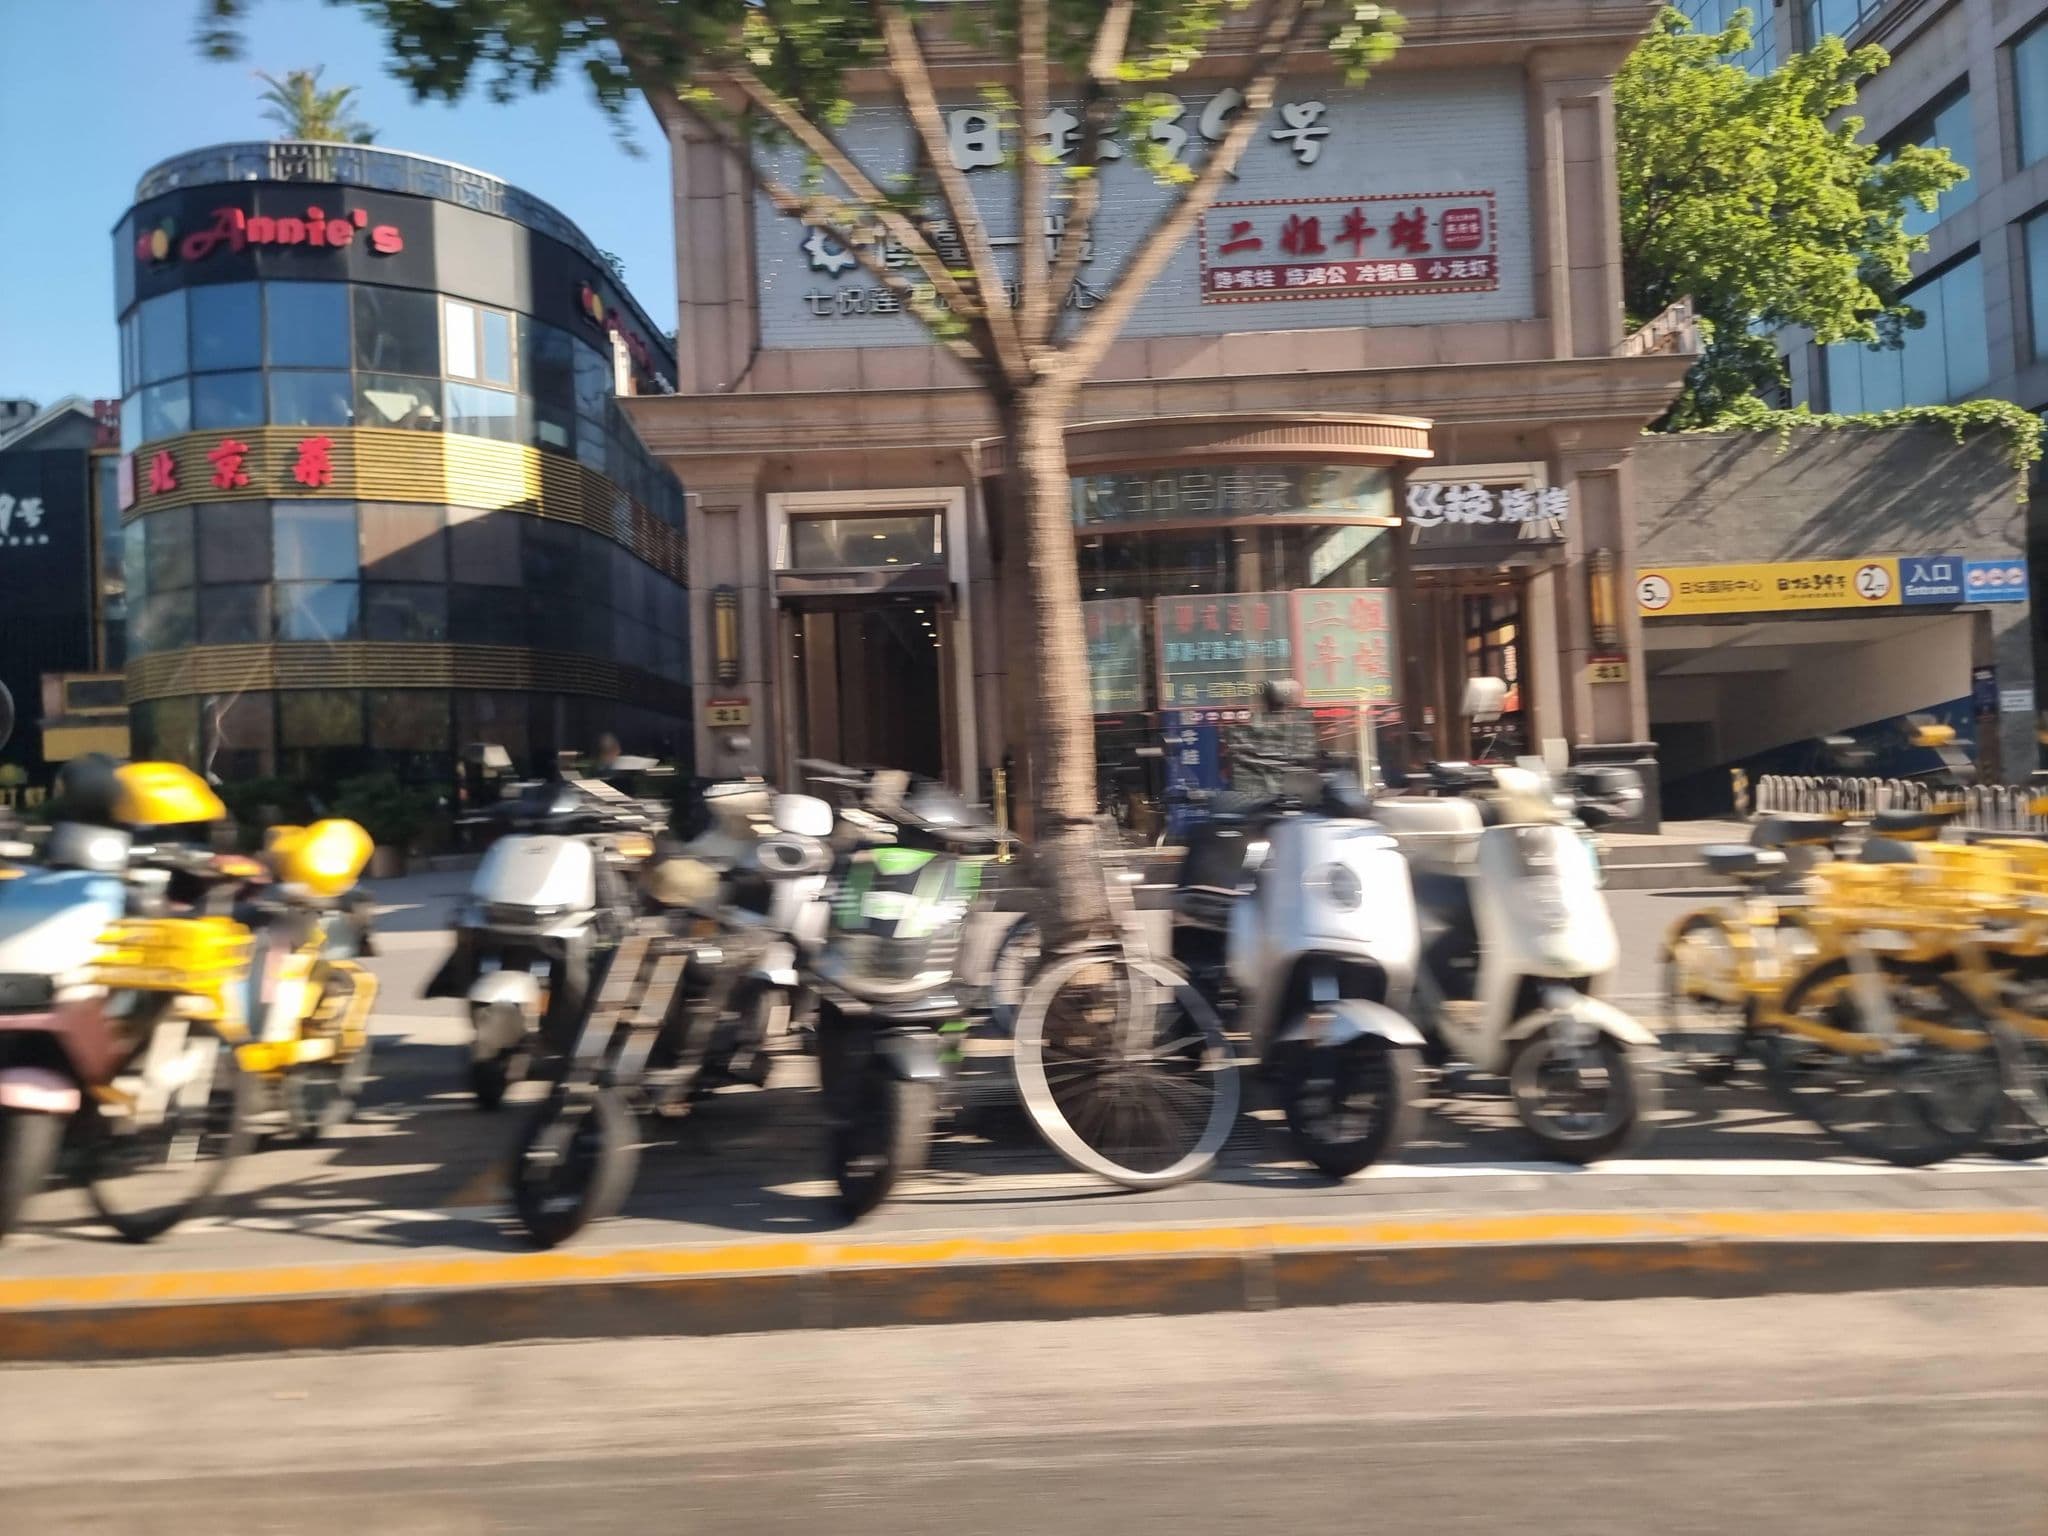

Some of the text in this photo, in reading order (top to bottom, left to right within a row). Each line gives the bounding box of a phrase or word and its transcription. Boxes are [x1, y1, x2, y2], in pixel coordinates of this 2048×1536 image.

[181, 206, 404, 261] Annie's
[1428, 260, 1489, 279] 小龙虾
[148, 435, 335, 495] 北京菜
[1910, 564, 1952, 583] 入口
